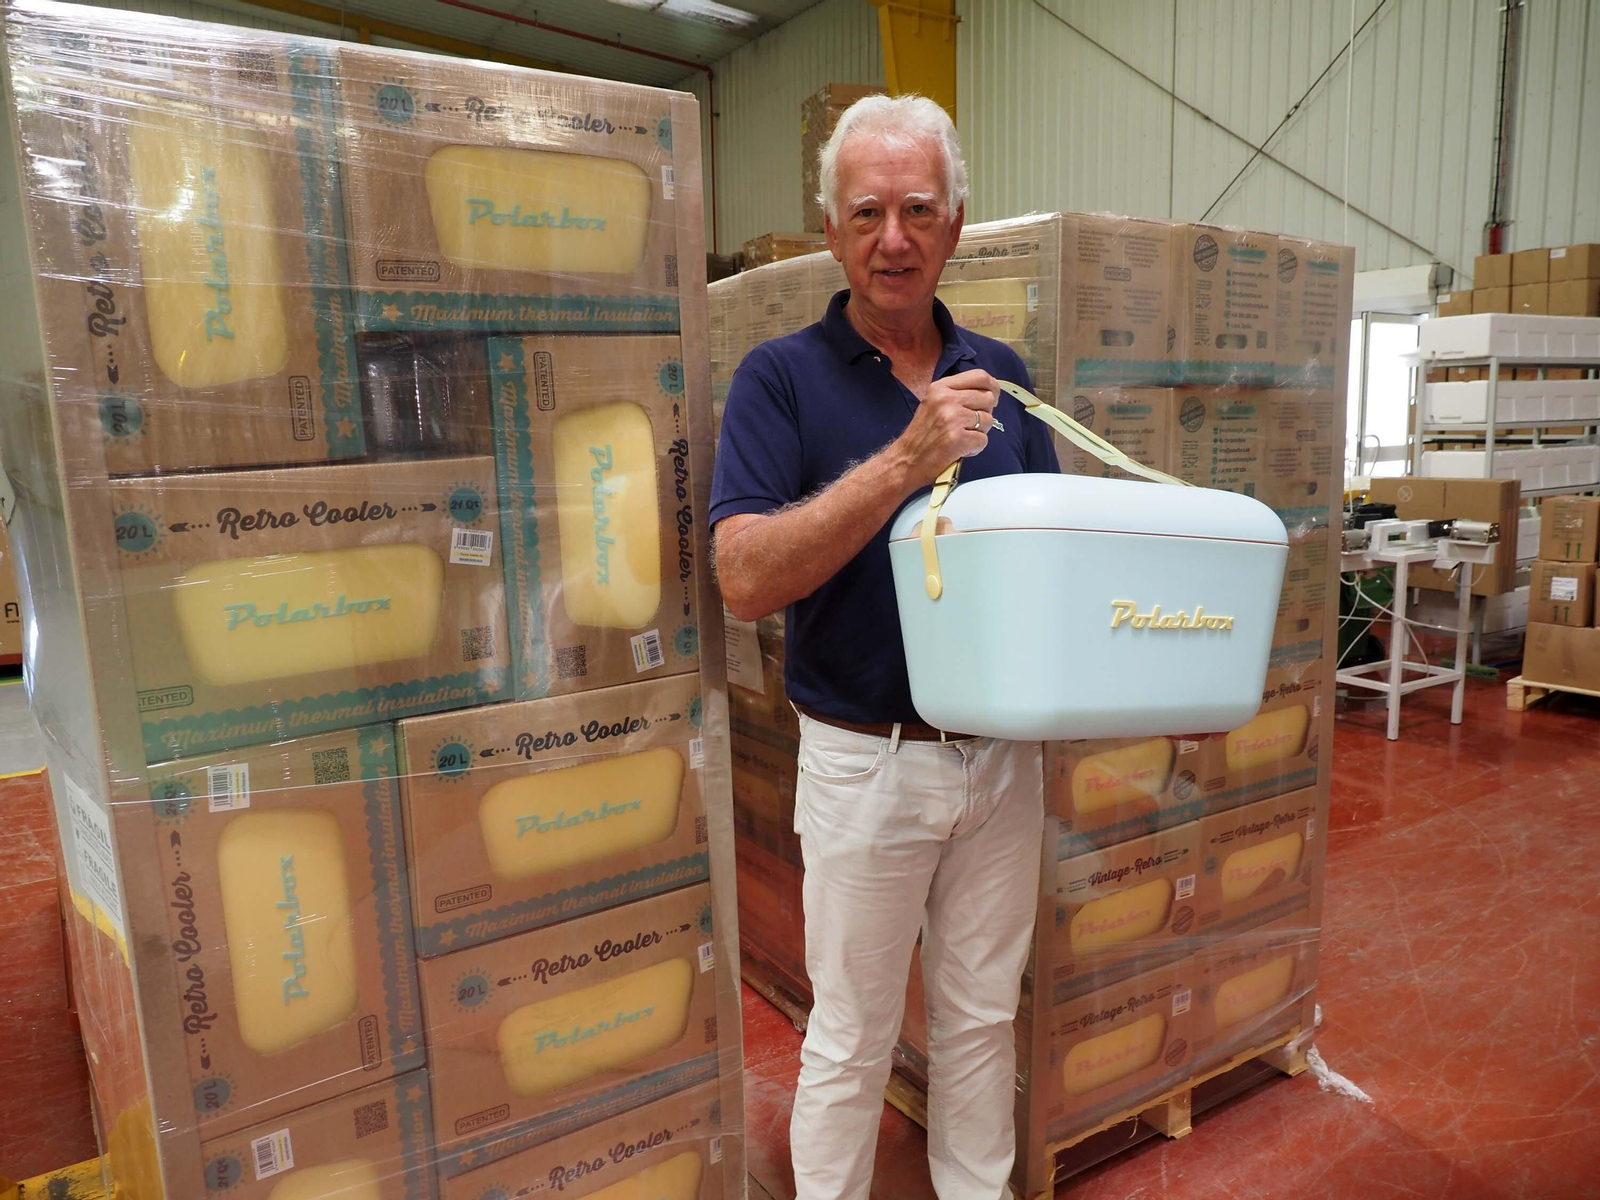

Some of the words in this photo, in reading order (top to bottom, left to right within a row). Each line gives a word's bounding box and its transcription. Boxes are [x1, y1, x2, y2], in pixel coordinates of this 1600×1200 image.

[465, 197, 608, 232] Polarbox
[202, 165, 235, 343] Polarbox
[380, 264, 435, 278] PATENTED
[86, 250, 127, 338] Retro
[411, 303, 515, 322] Maximum
[518, 303, 590, 322] thermal
[594, 304, 676, 323] insulation
[537, 355, 551, 407] PATENTED
[667, 363, 679, 379] 20
[112, 411, 129, 435] 20
[295, 380, 310, 437] PATENTED
[498, 381, 522, 486] Maximum
[668, 438, 690, 502] Retro
[115, 524, 139, 541] 20
[141, 524, 154, 538] L
[217, 506, 299, 540] Retro
[303, 500, 398, 527] Cooler
[588, 444, 615, 585] Polarbox
[674, 504, 691, 583] Cooler
[223, 593, 392, 632] Polarbox
[1110, 599, 1236, 631] Polarbox
[138, 690, 189, 708] TENTED
[161, 716, 285, 751] Maximum
[288, 700, 373, 731] thermal
[376, 685, 476, 715] insulation
[438, 754, 457, 769] 20
[459, 754, 468, 765] L
[515, 731, 578, 761] Retro
[580, 714, 651, 742] Cooler
[375, 764, 399, 861] insulation
[514, 797, 643, 838] Polarbox
[1088, 854, 1163, 887] Vintage-Retro
[171, 871, 201, 963] Cooler
[384, 863, 405, 933] thermal
[438, 888, 488, 909] PATENTED
[464, 906, 557, 940] Maximum
[554, 884, 628, 914] thermal
[629, 863, 703, 894] insulation
[277, 854, 310, 1006] Polarbox
[530, 951, 591, 985] Retro
[594, 929, 663, 962] Cooler
[182, 963, 218, 1035] Retro
[394, 937, 415, 1033] Maximum
[457, 985, 475, 1001] 20
[476, 984, 487, 996] L
[363, 1020, 377, 1066] PATENTED
[533, 1003, 656, 1055] Polarbox
[205, 1090, 220, 1110] 20
[459, 1107, 506, 1131] PATENTED
[549, 1155, 606, 1191] Retro
[608, 1127, 674, 1164] Cooler
